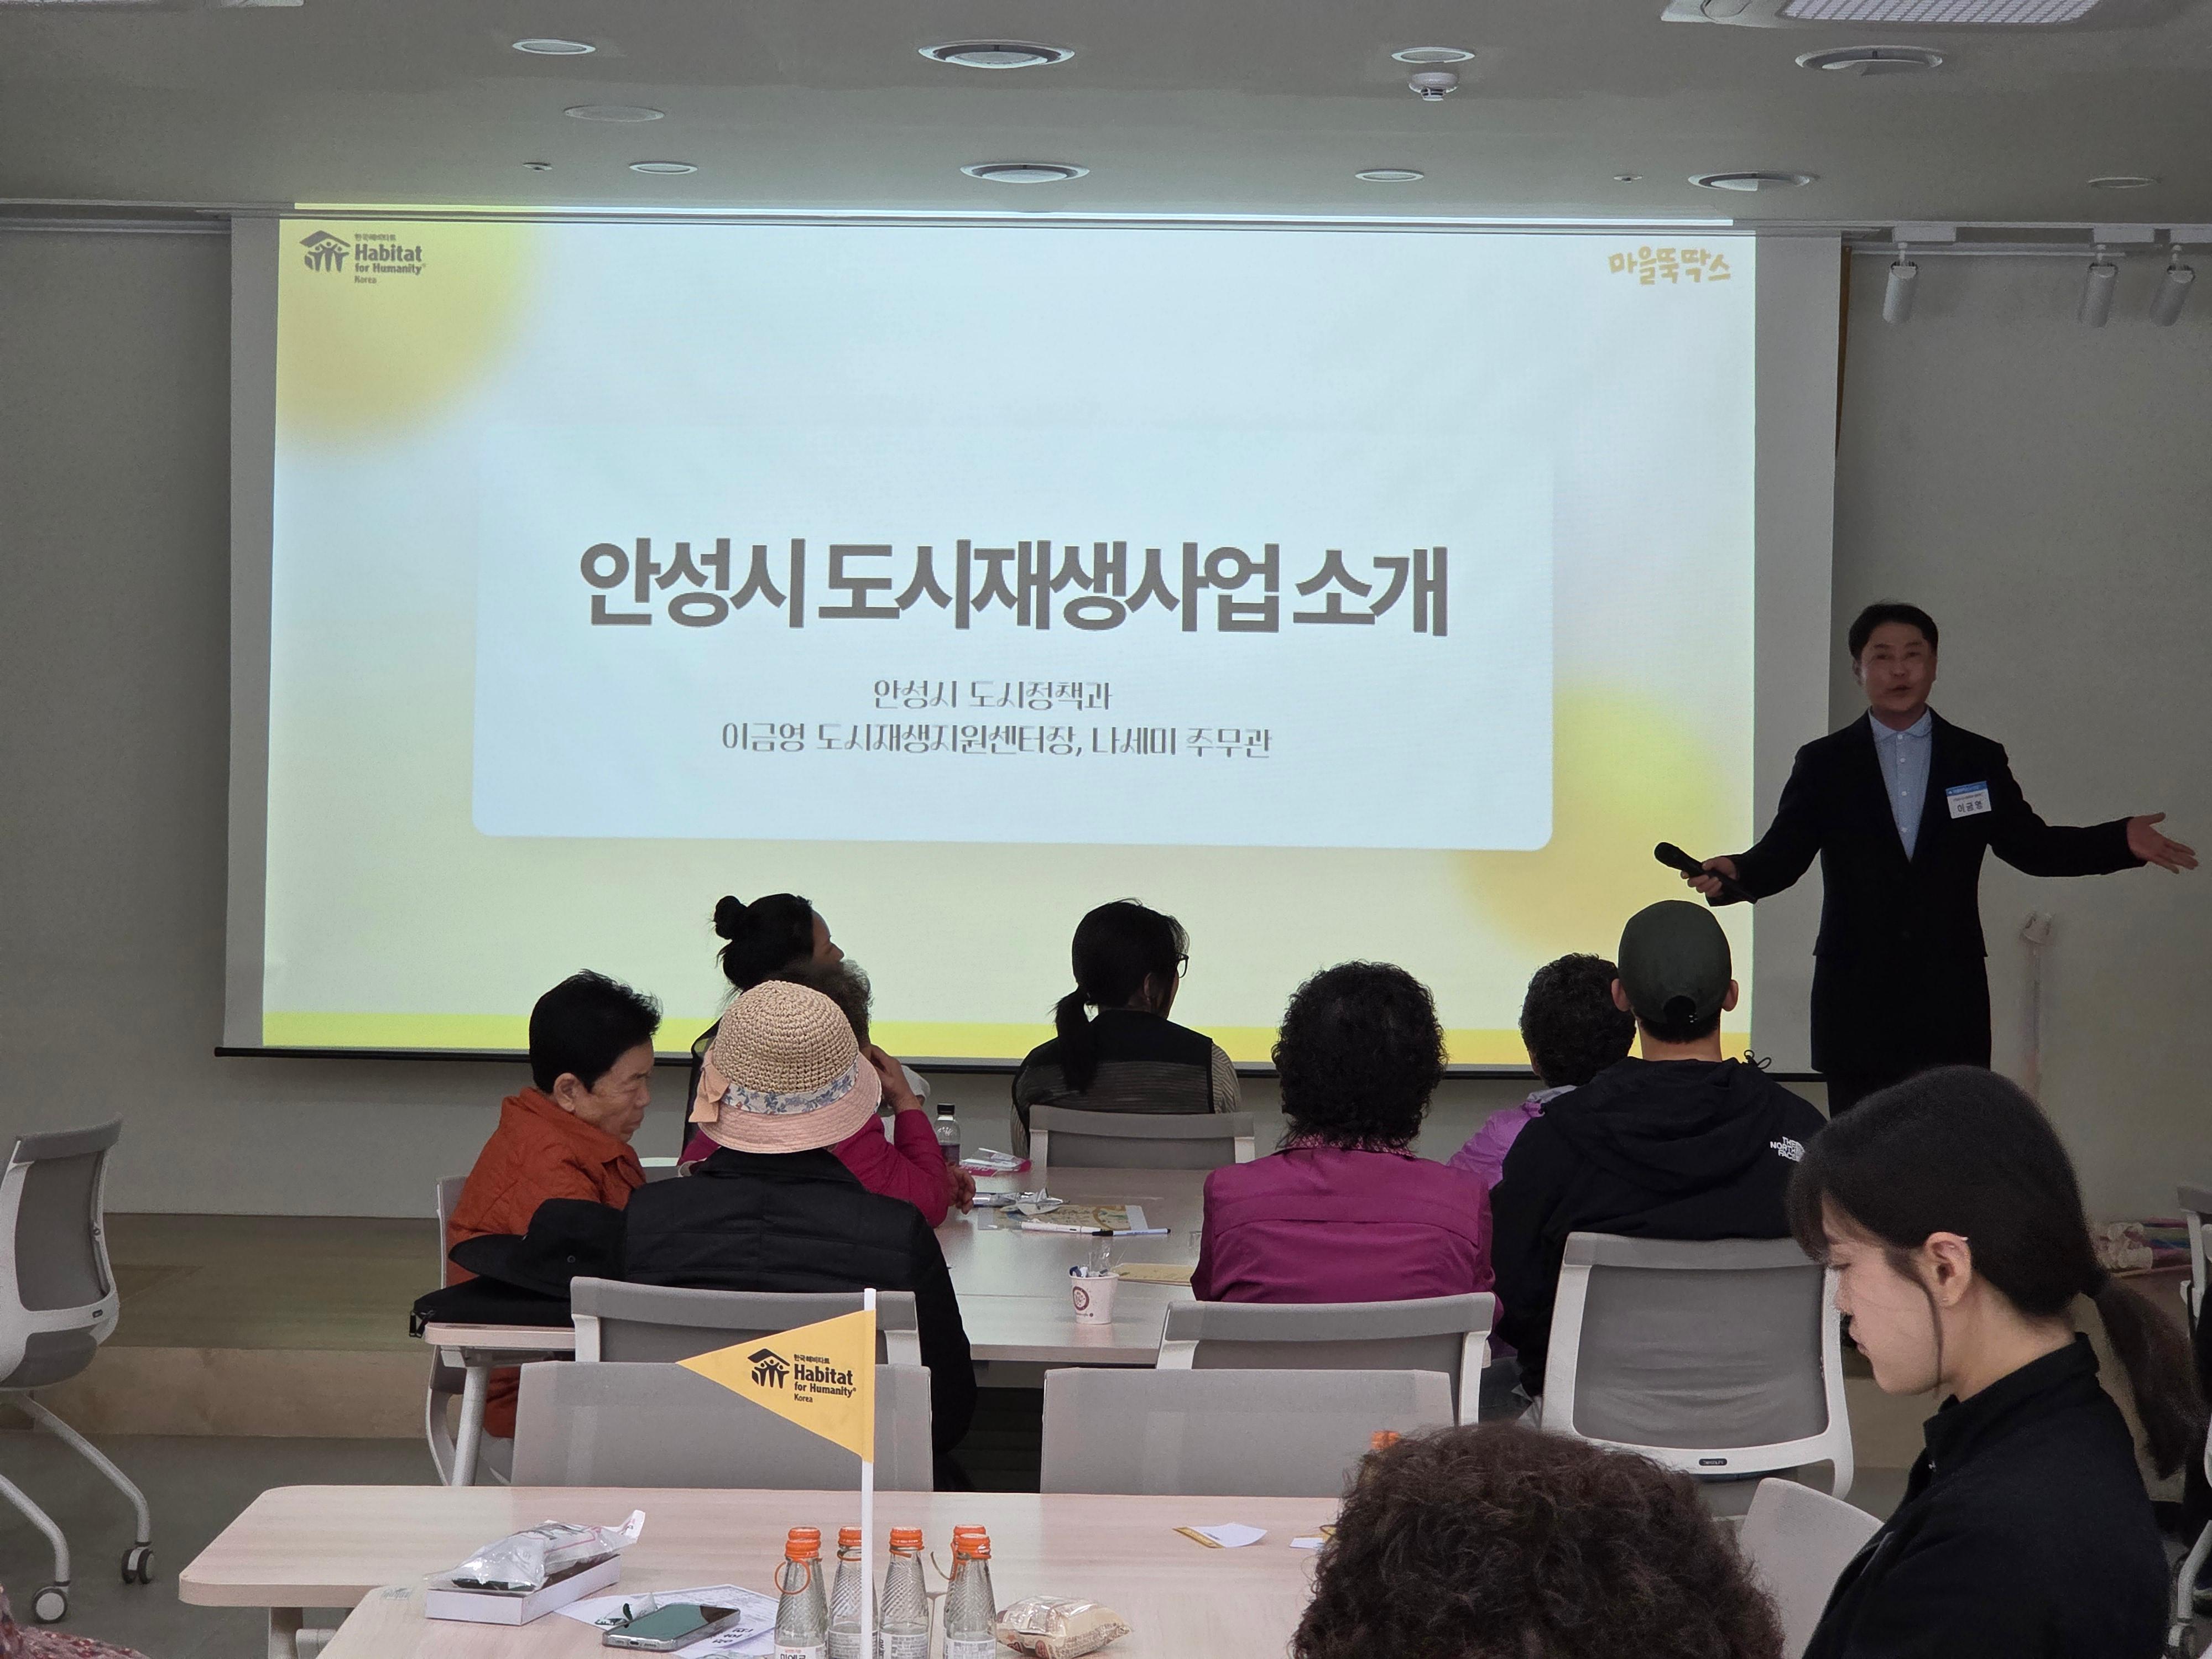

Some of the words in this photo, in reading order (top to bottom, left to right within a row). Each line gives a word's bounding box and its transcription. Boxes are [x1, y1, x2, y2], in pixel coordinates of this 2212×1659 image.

[354, 243, 422, 263] Habitat
[354, 263, 369, 273] for
[372, 263, 422, 275] Humanity
[1608, 246, 1731, 285] 마을뚝딱스
[354, 275, 377, 284] Korea
[581, 538, 806, 629] 안성시
[818, 539, 1280, 633] 도시재생사업
[1293, 546, 1448, 637] 소개
[874, 680, 957, 709] 안성시
[969, 681, 1113, 711] 도시정책과
[722, 723, 805, 752] 이금영
[817, 724, 1082, 757] 도시재생지원센터장,
[1093, 727, 1176, 755] 나세미
[1187, 728, 1273, 758] 주무관
[1770, 1141, 1796, 1153] NORTH
[1782, 1136, 1796, 1146] THE
[1778, 1149, 1797, 1160] FACE
[794, 1364, 853, 1385] Habitat
[794, 1381, 807, 1392] for
[810, 1383, 853, 1398] Humanity
[794, 1393, 813, 1403] Korea
